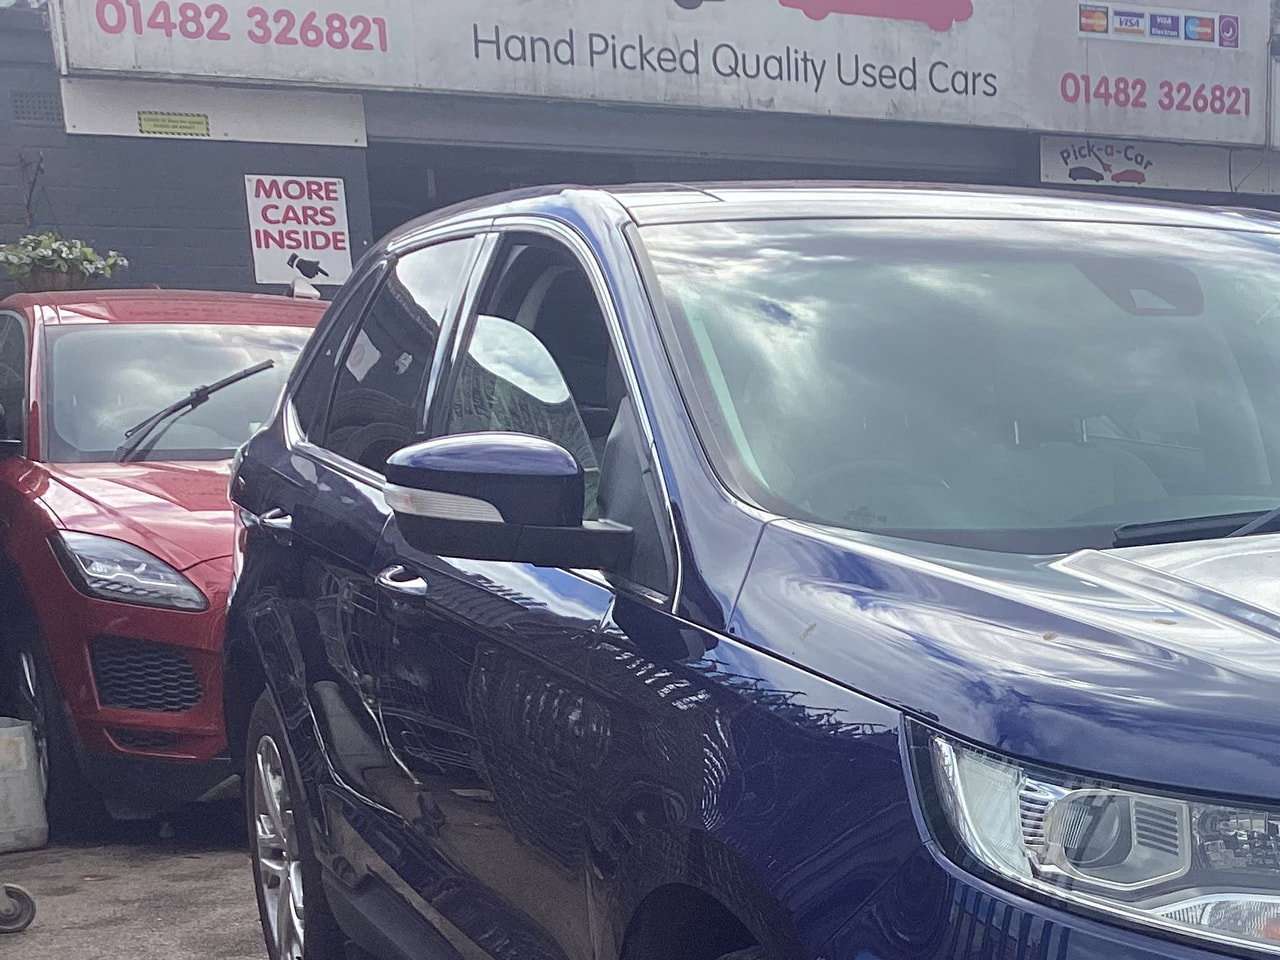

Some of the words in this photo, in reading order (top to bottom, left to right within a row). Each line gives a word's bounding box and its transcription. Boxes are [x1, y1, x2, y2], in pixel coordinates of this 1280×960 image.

[95, 0, 231, 41] 01482
[247, 6, 387, 52] 326821
[1119, 16, 1140, 28] VISA
[473, 23, 575, 66] Hand
[588, 33, 699, 75] Picked
[712, 44, 826, 93] Quality
[837, 53, 917, 91] Used
[928, 61, 998, 97] Cars
[1060, 72, 1147, 108] 01482
[1158, 80, 1250, 116] 326821
[254, 178, 339, 201] MORE
[261, 204, 337, 226] CARS
[254, 229, 347, 251] INSIDE
